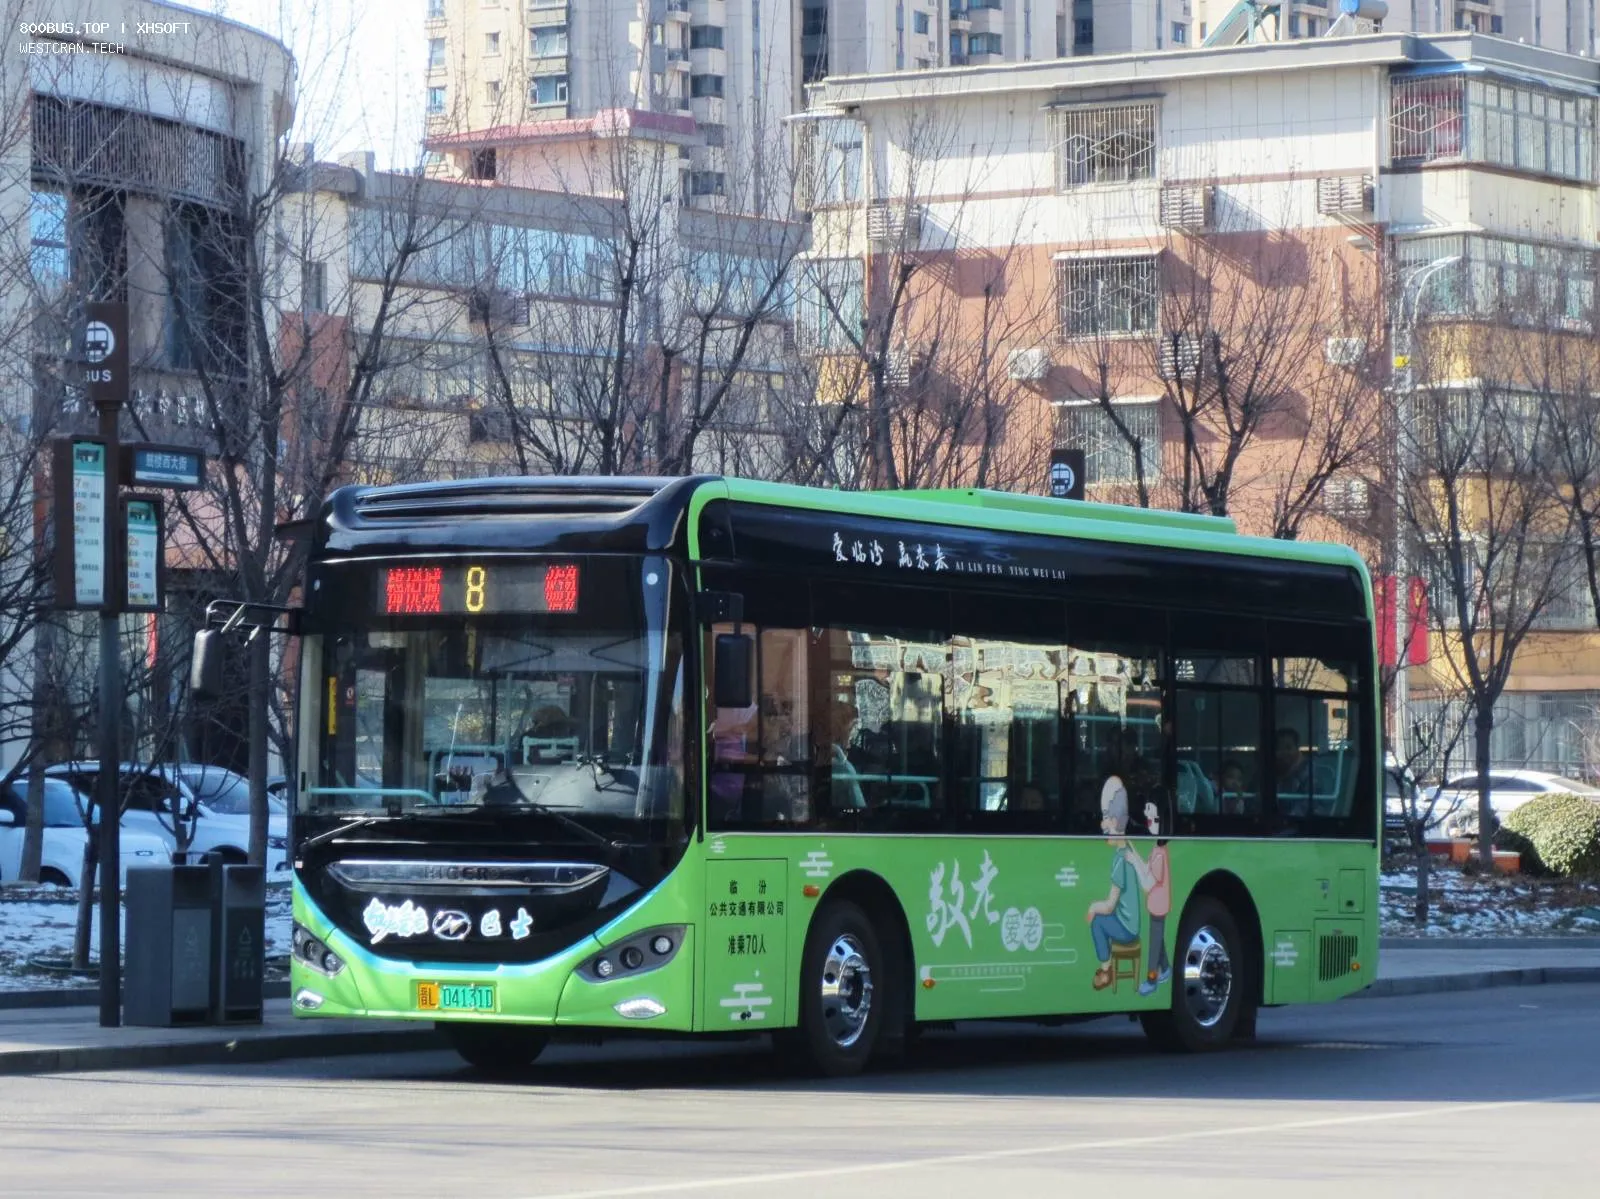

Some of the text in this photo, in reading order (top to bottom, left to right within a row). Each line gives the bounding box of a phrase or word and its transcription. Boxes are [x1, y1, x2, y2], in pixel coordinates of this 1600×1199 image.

[955, 561, 1066, 580] AI LIN FEN YING WEI LAI
[466, 567, 485, 612] 8
[709, 901, 784, 917] 公共交通有限公司
[926, 849, 1000, 949] 敬老
[728, 935, 767, 955] 准乘70人
[442, 987, 493, 1008] 04131D
